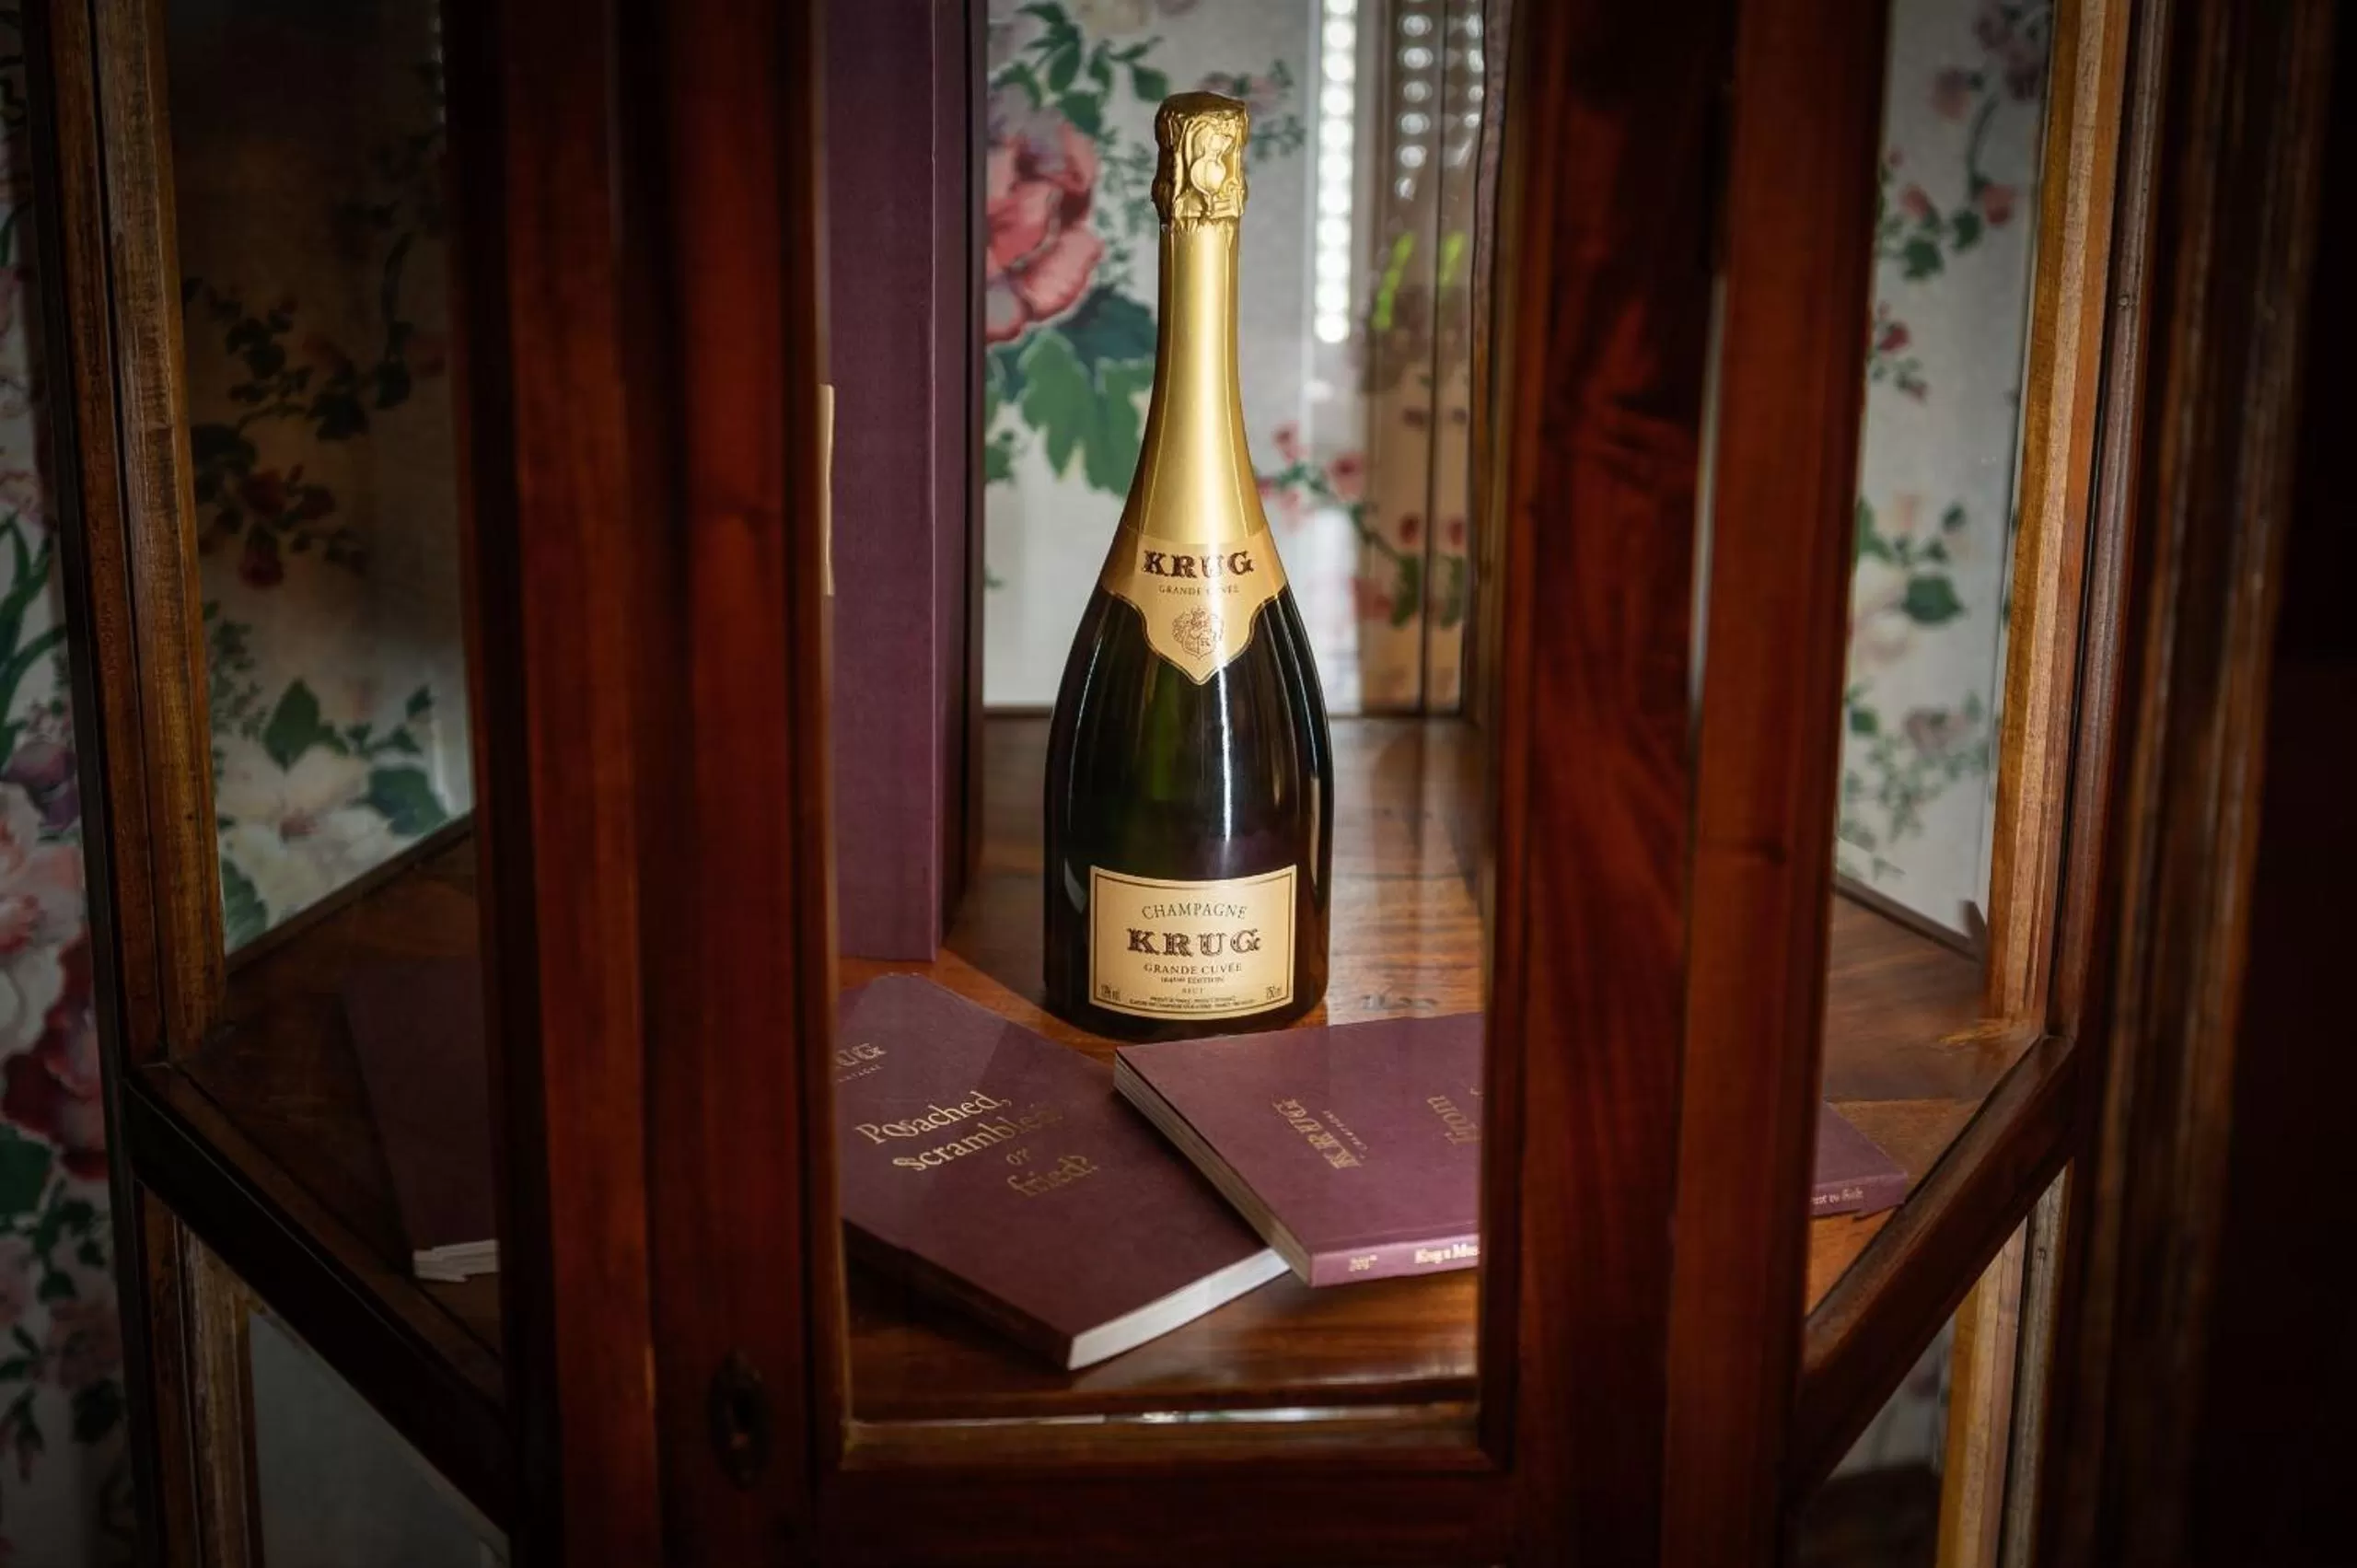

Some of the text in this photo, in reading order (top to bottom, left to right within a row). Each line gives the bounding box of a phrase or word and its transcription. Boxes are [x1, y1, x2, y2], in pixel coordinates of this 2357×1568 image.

[1143, 550, 1255, 578] KRUG
[1142, 902, 1248, 920] CHAMPAGNE
[1126, 927, 1262, 958] KRUG
[1144, 962, 1198, 975] GRANDE
[836, 1042, 888, 1067] UG
